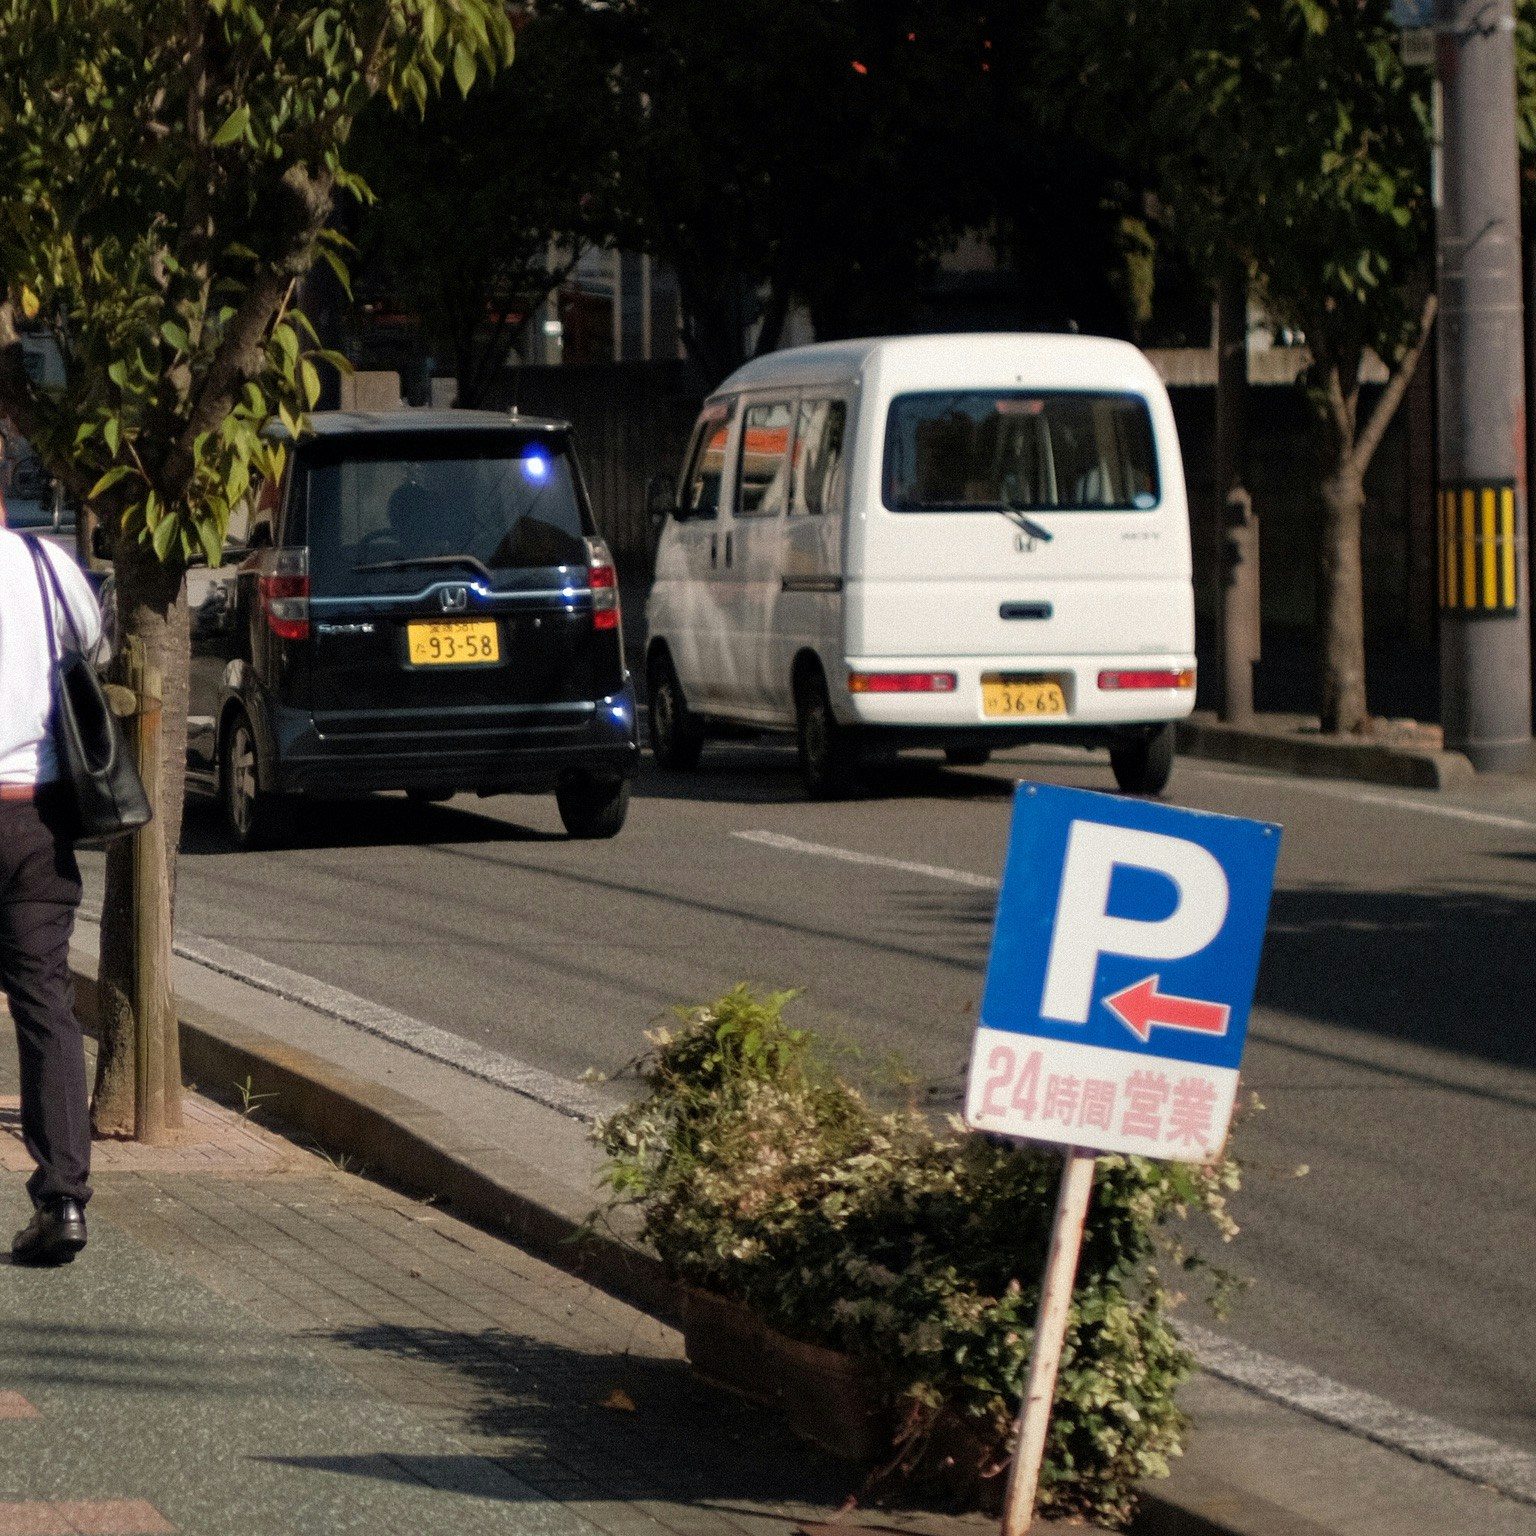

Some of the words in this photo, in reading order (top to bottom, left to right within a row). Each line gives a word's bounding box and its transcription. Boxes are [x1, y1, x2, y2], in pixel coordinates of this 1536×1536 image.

[429, 635, 492, 659] 93-58
[1002, 691, 1059, 712] 36-65
[1041, 819, 1229, 1024] P
[980, 1045, 1218, 1147] 24時間営業
